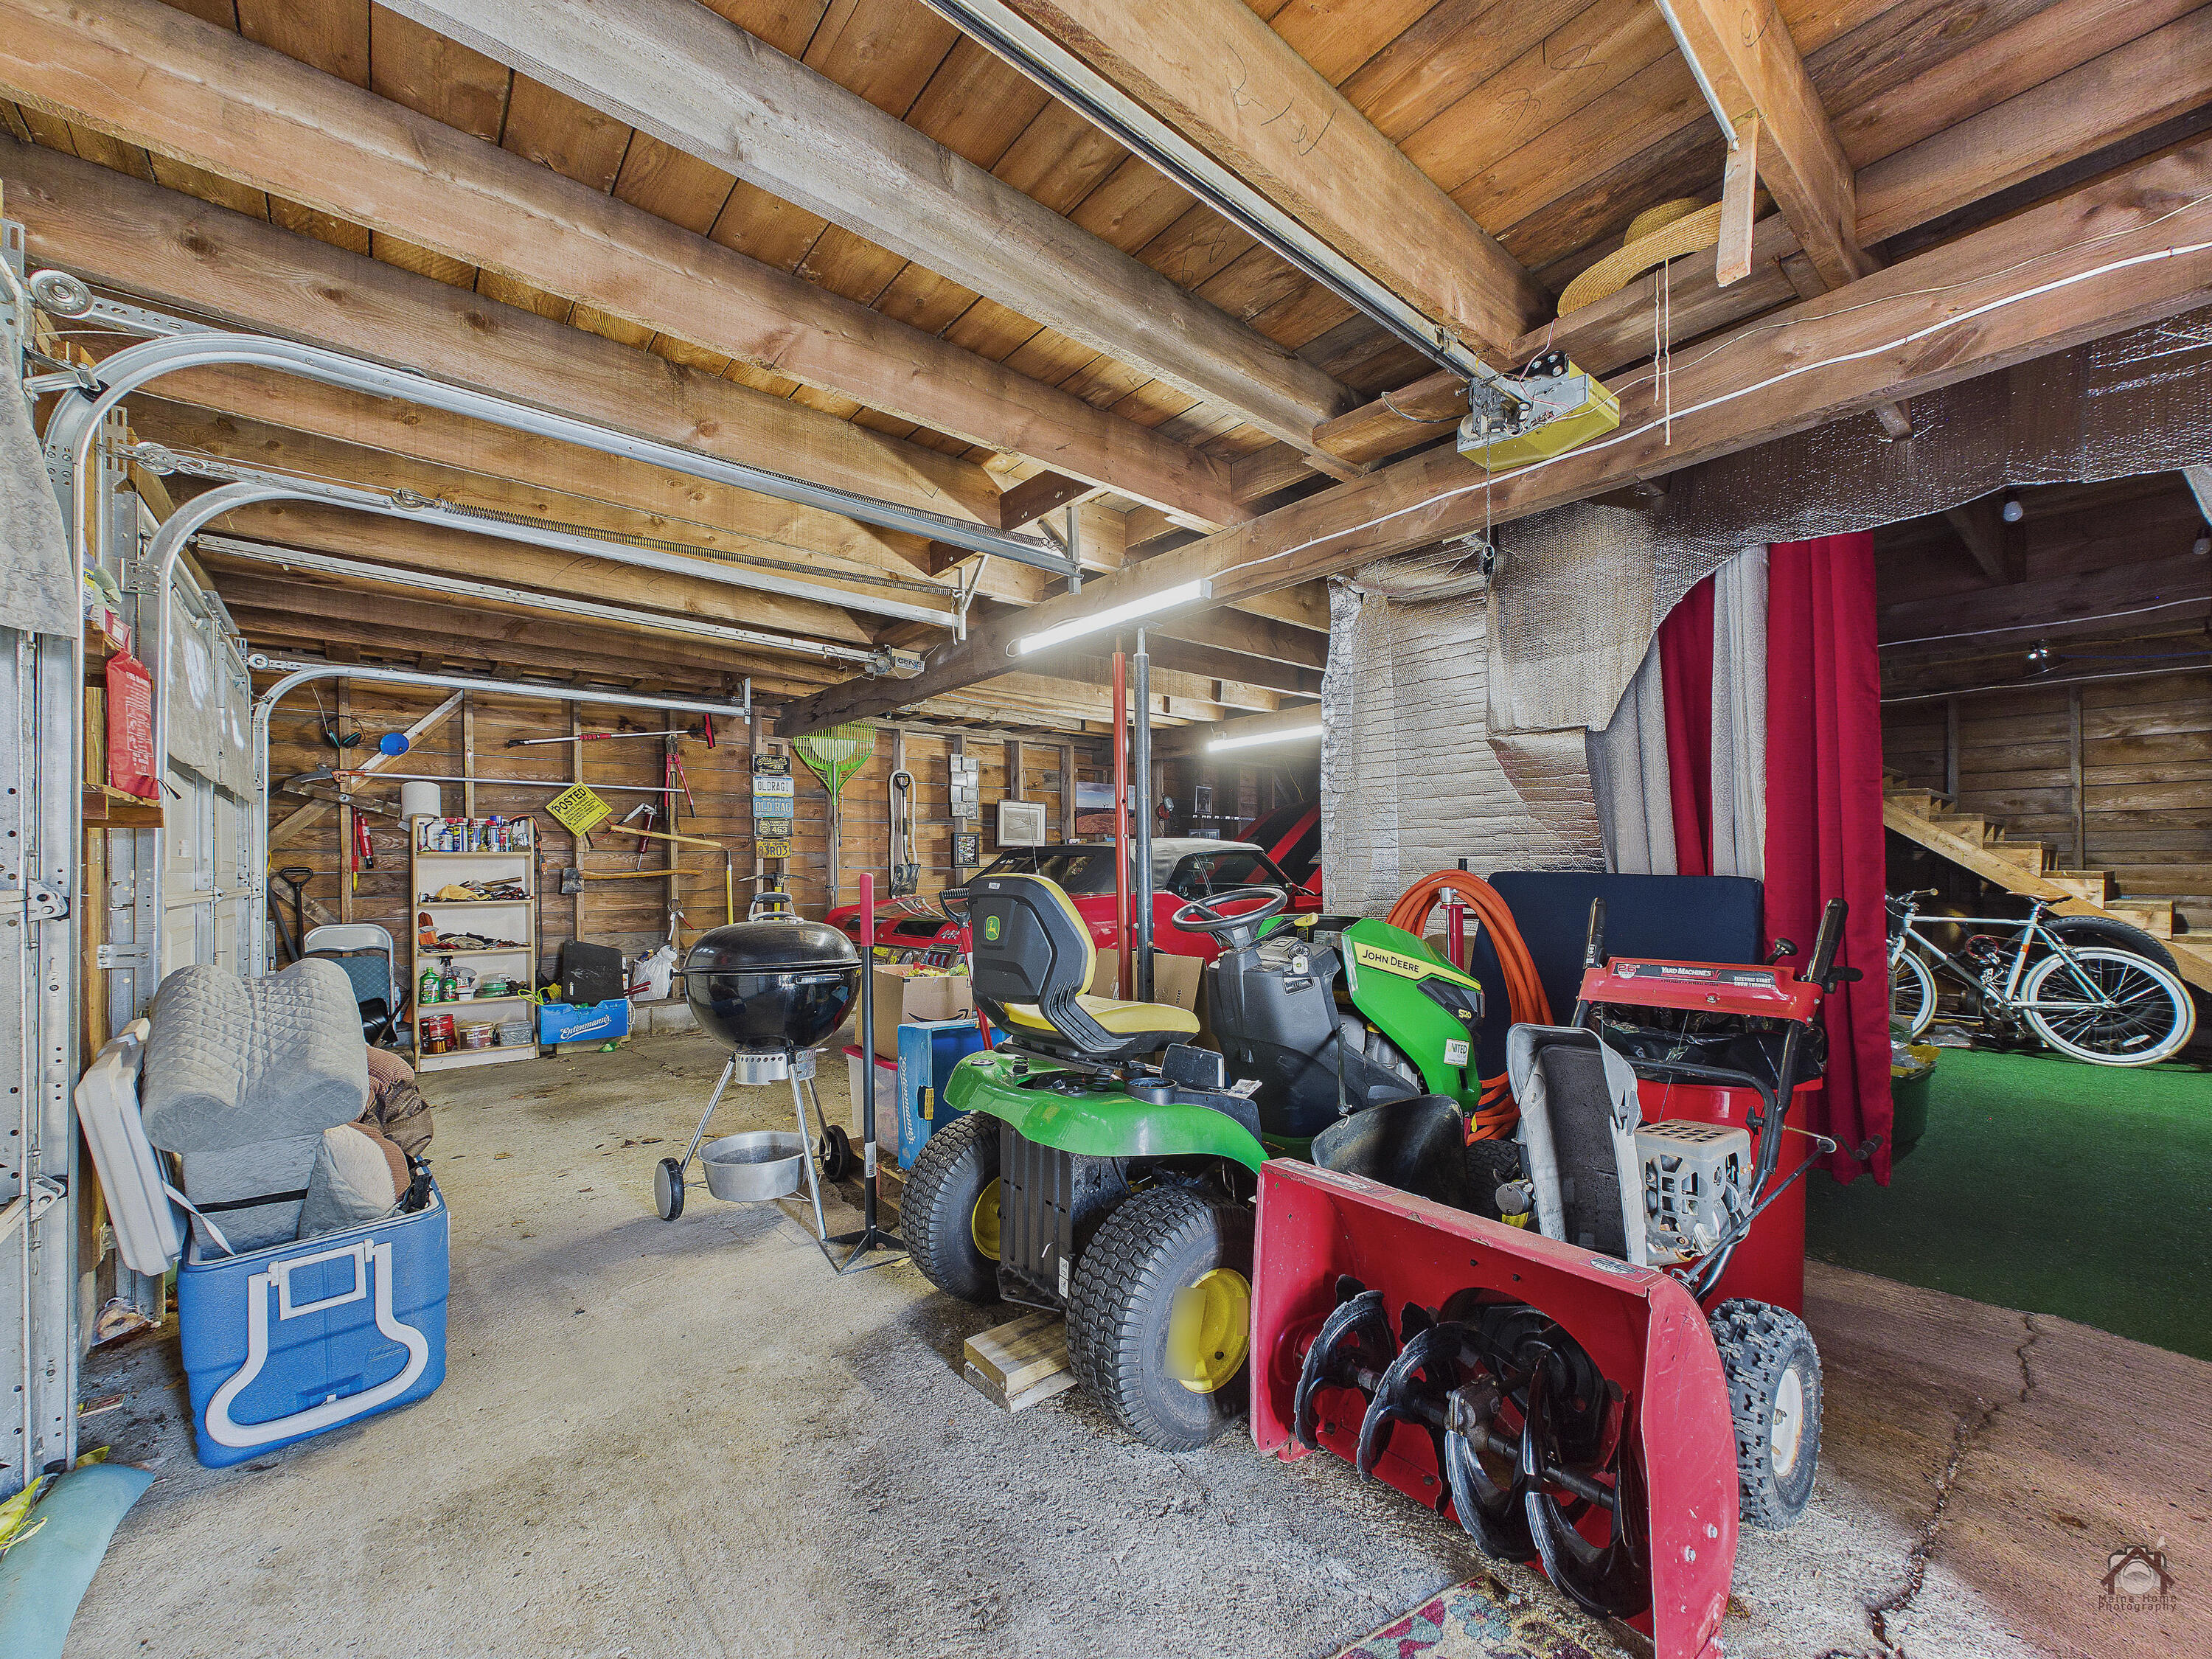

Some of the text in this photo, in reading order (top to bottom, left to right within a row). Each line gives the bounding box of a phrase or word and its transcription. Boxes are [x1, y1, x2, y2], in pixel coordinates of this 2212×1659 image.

[554, 788, 587, 814] POSTED
[755, 801, 791, 813] OLD RAG
[1363, 950, 1419, 973] JOHN DEERE
[1661, 967, 1712, 976] YARD MACHINES
[560, 1014, 611, 1040] Entenmann's
